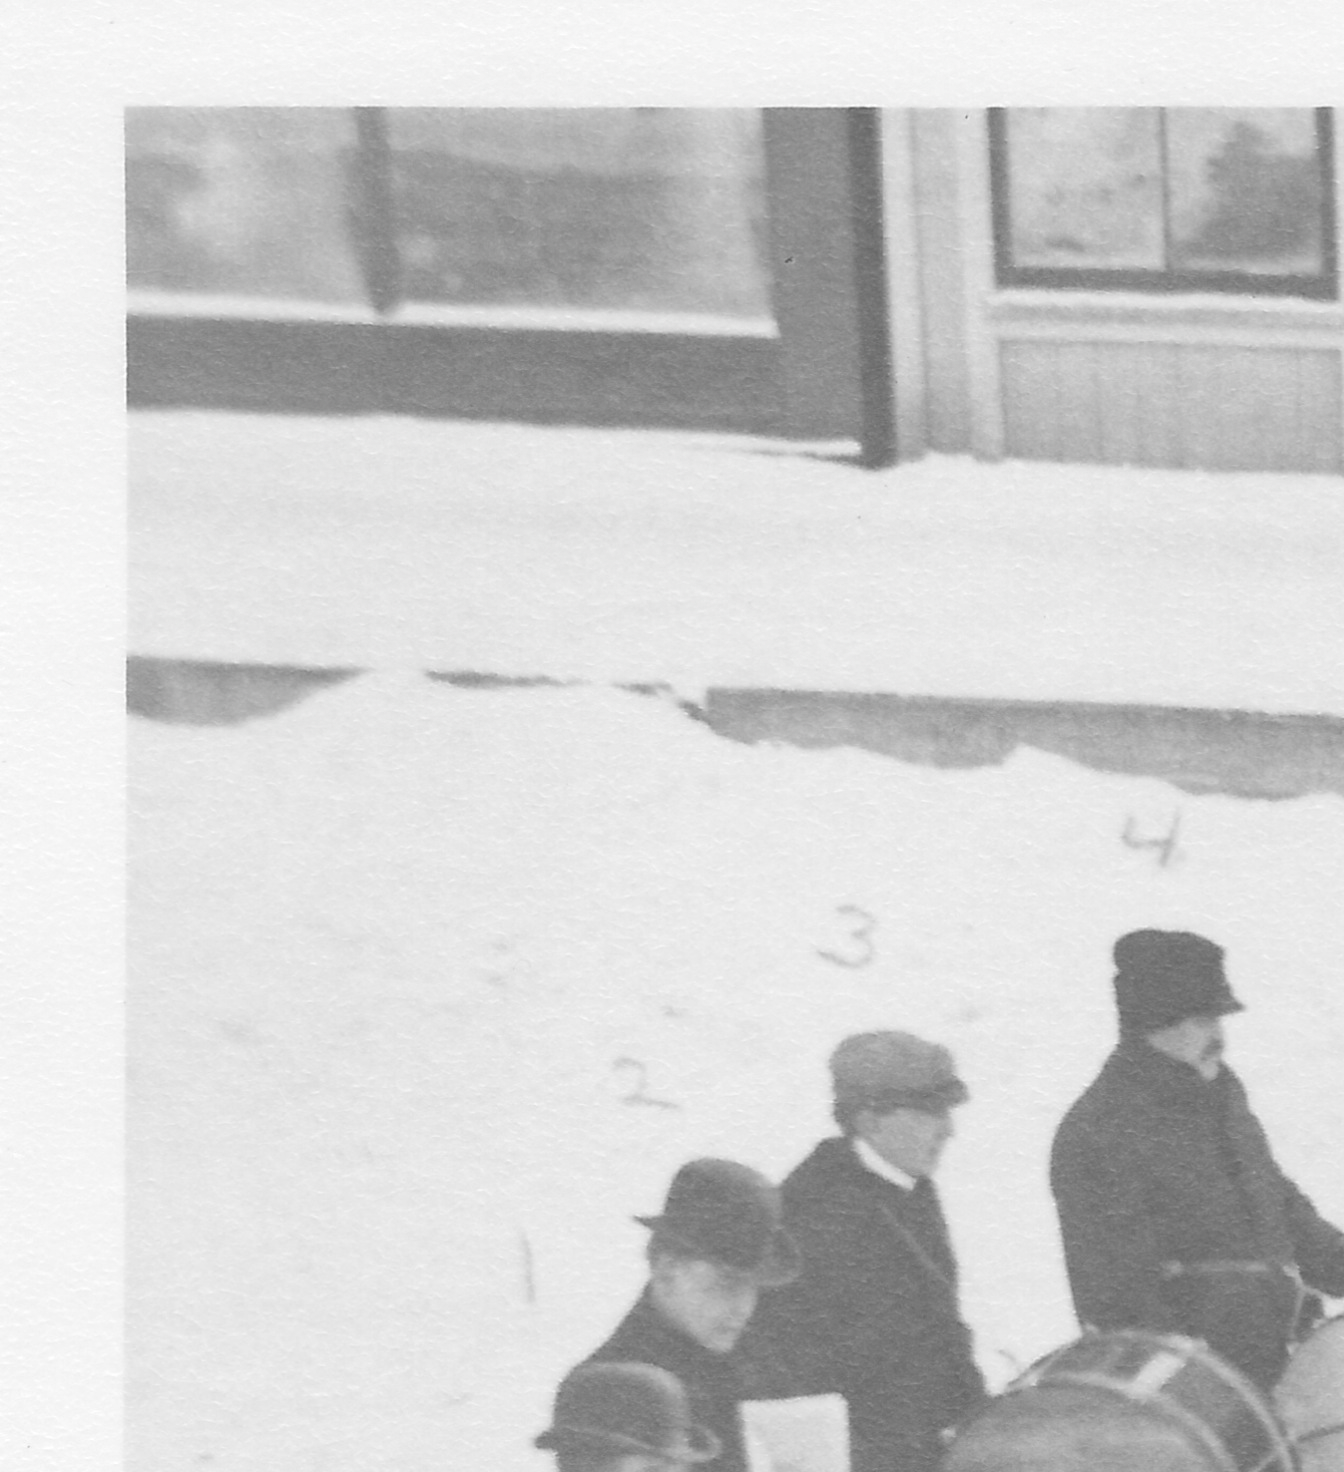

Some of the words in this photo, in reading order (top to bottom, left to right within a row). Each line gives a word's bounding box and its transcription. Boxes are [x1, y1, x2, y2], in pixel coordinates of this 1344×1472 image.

[1119, 808, 1181, 869] 4
[817, 905, 871, 968] 3
[614, 1057, 678, 1109] 2
